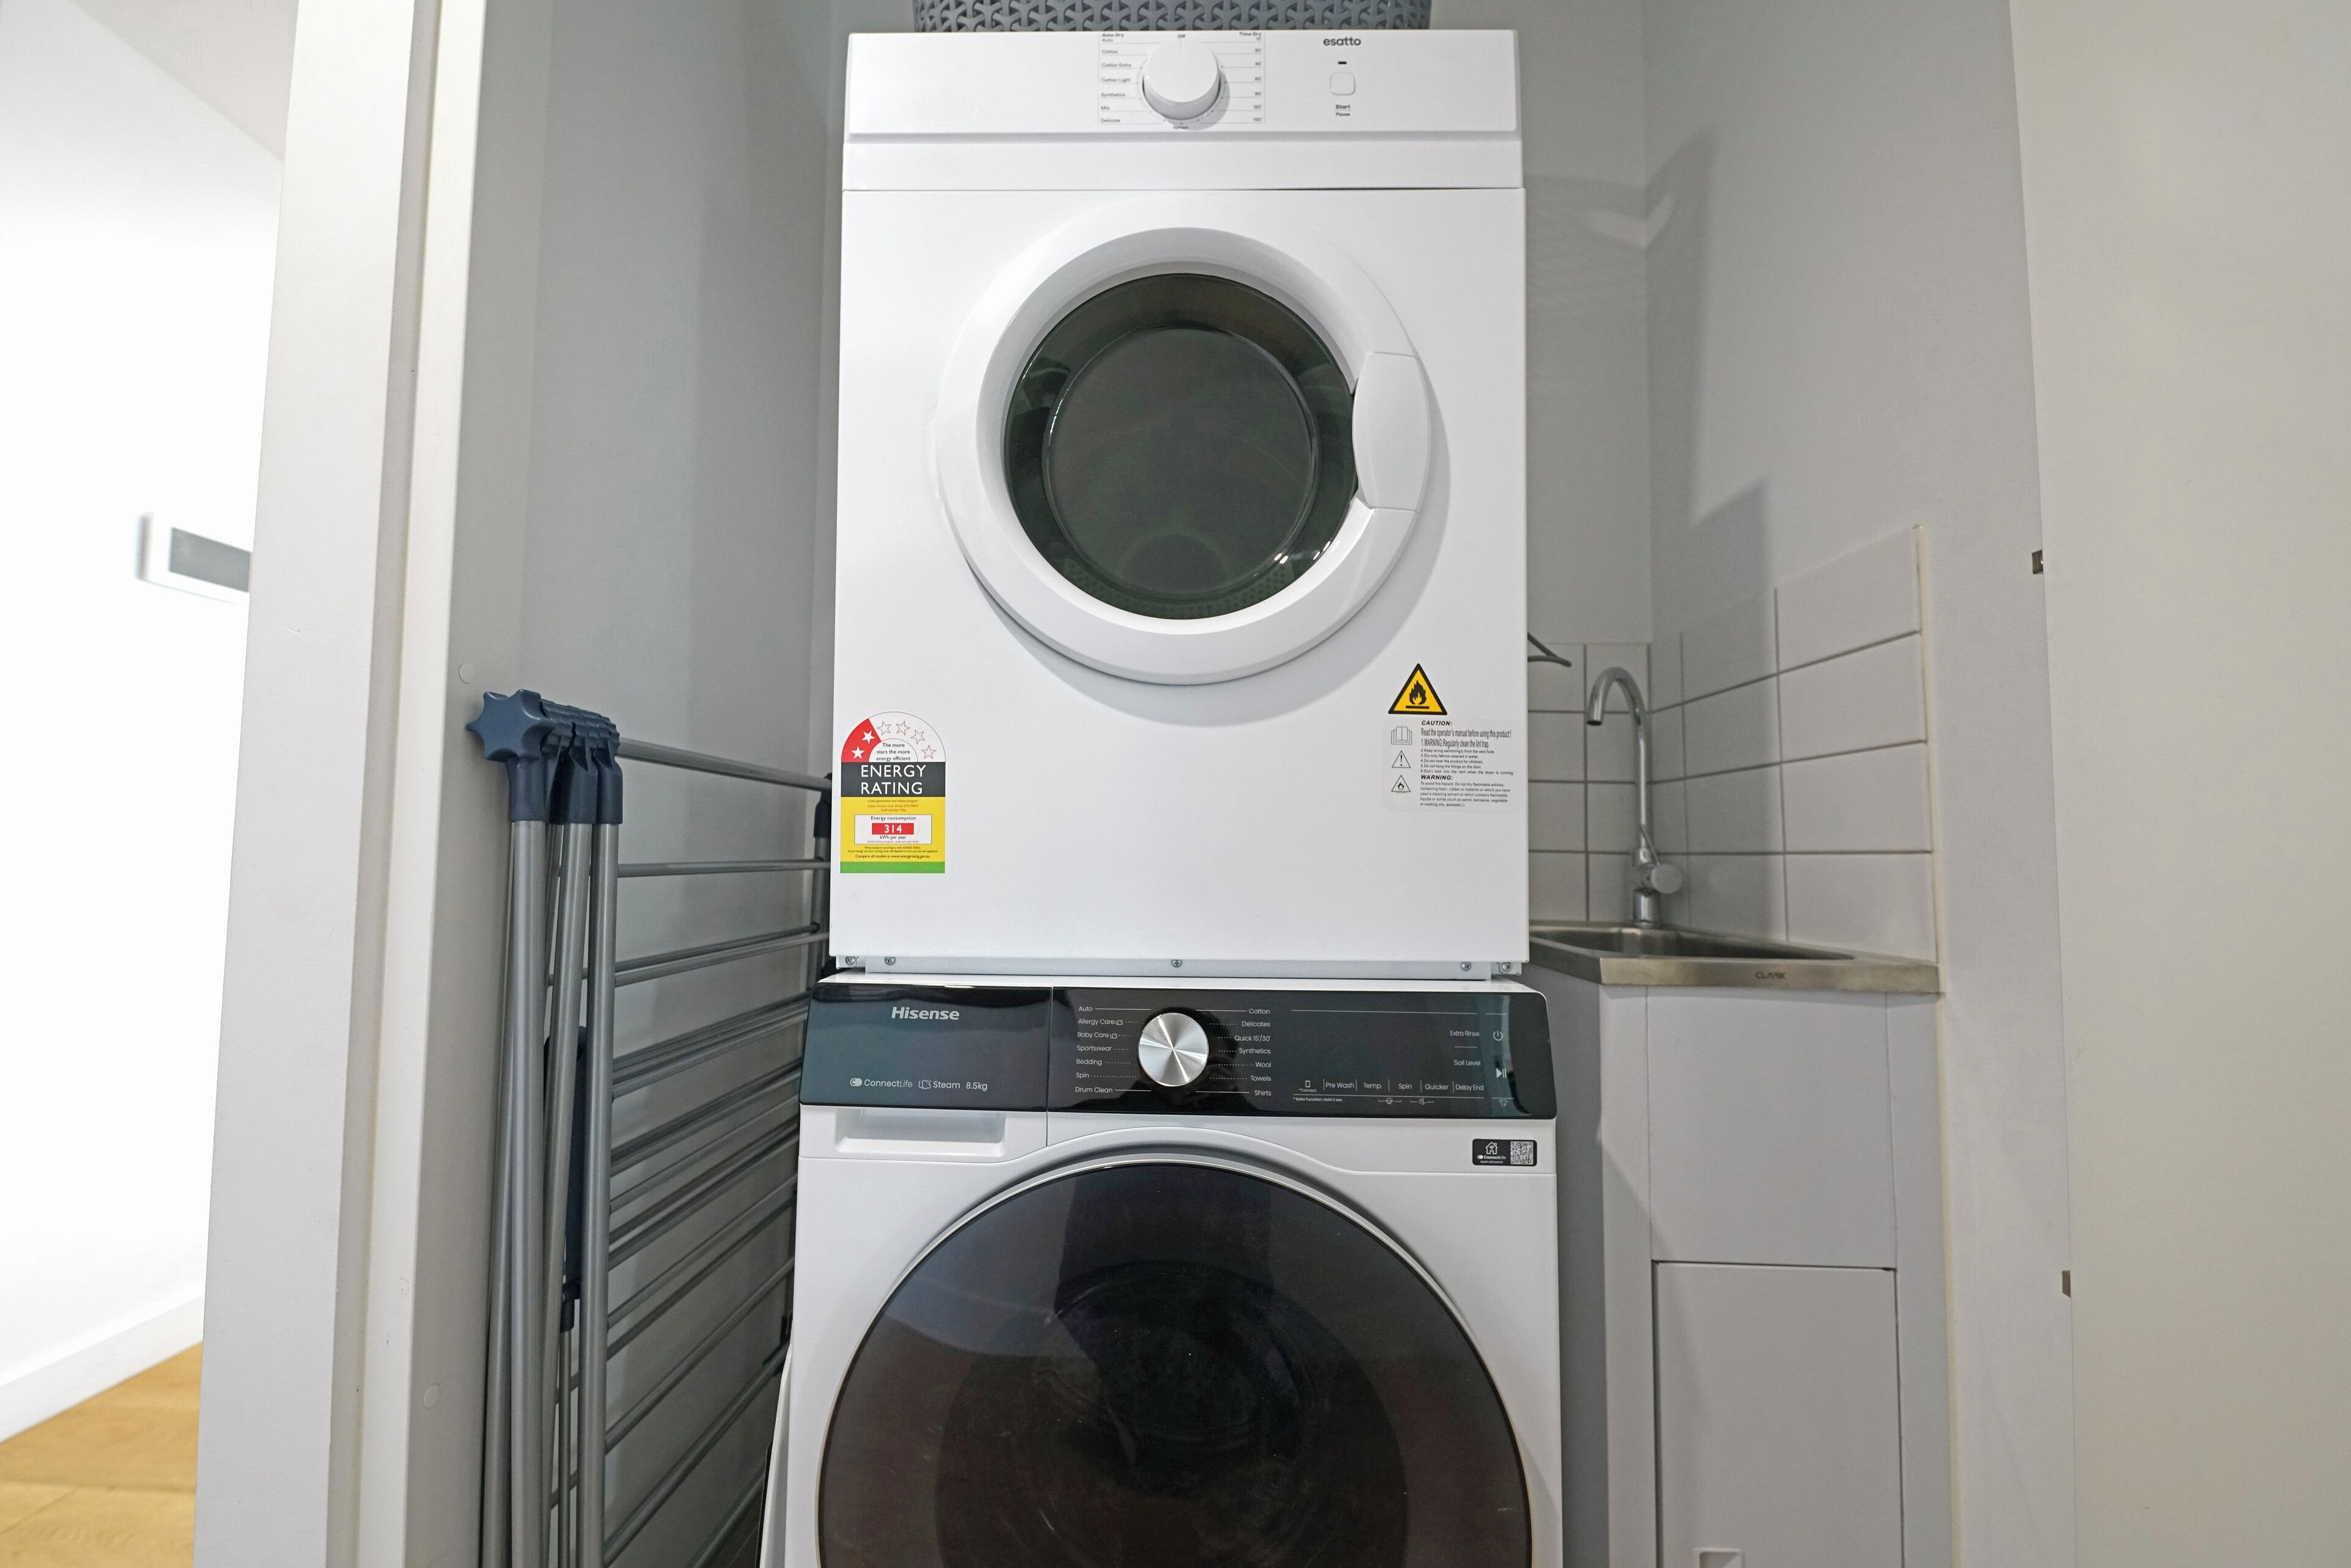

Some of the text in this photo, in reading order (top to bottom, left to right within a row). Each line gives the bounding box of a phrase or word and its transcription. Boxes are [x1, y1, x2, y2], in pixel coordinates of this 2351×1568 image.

[1323, 37, 1361, 46] esatto
[1421, 728, 1430, 737] Read
[1455, 729, 1468, 737] manual
[1468, 729, 1479, 737] before
[1480, 730, 1490, 740] using
[861, 764, 926, 778] ENERGY
[861, 782, 923, 795] RATING
[884, 824, 902, 833] 314
[891, 1007, 959, 1020] Hisense
[864, 1079, 988, 1092] ConnectLife Steam 8.5kg
